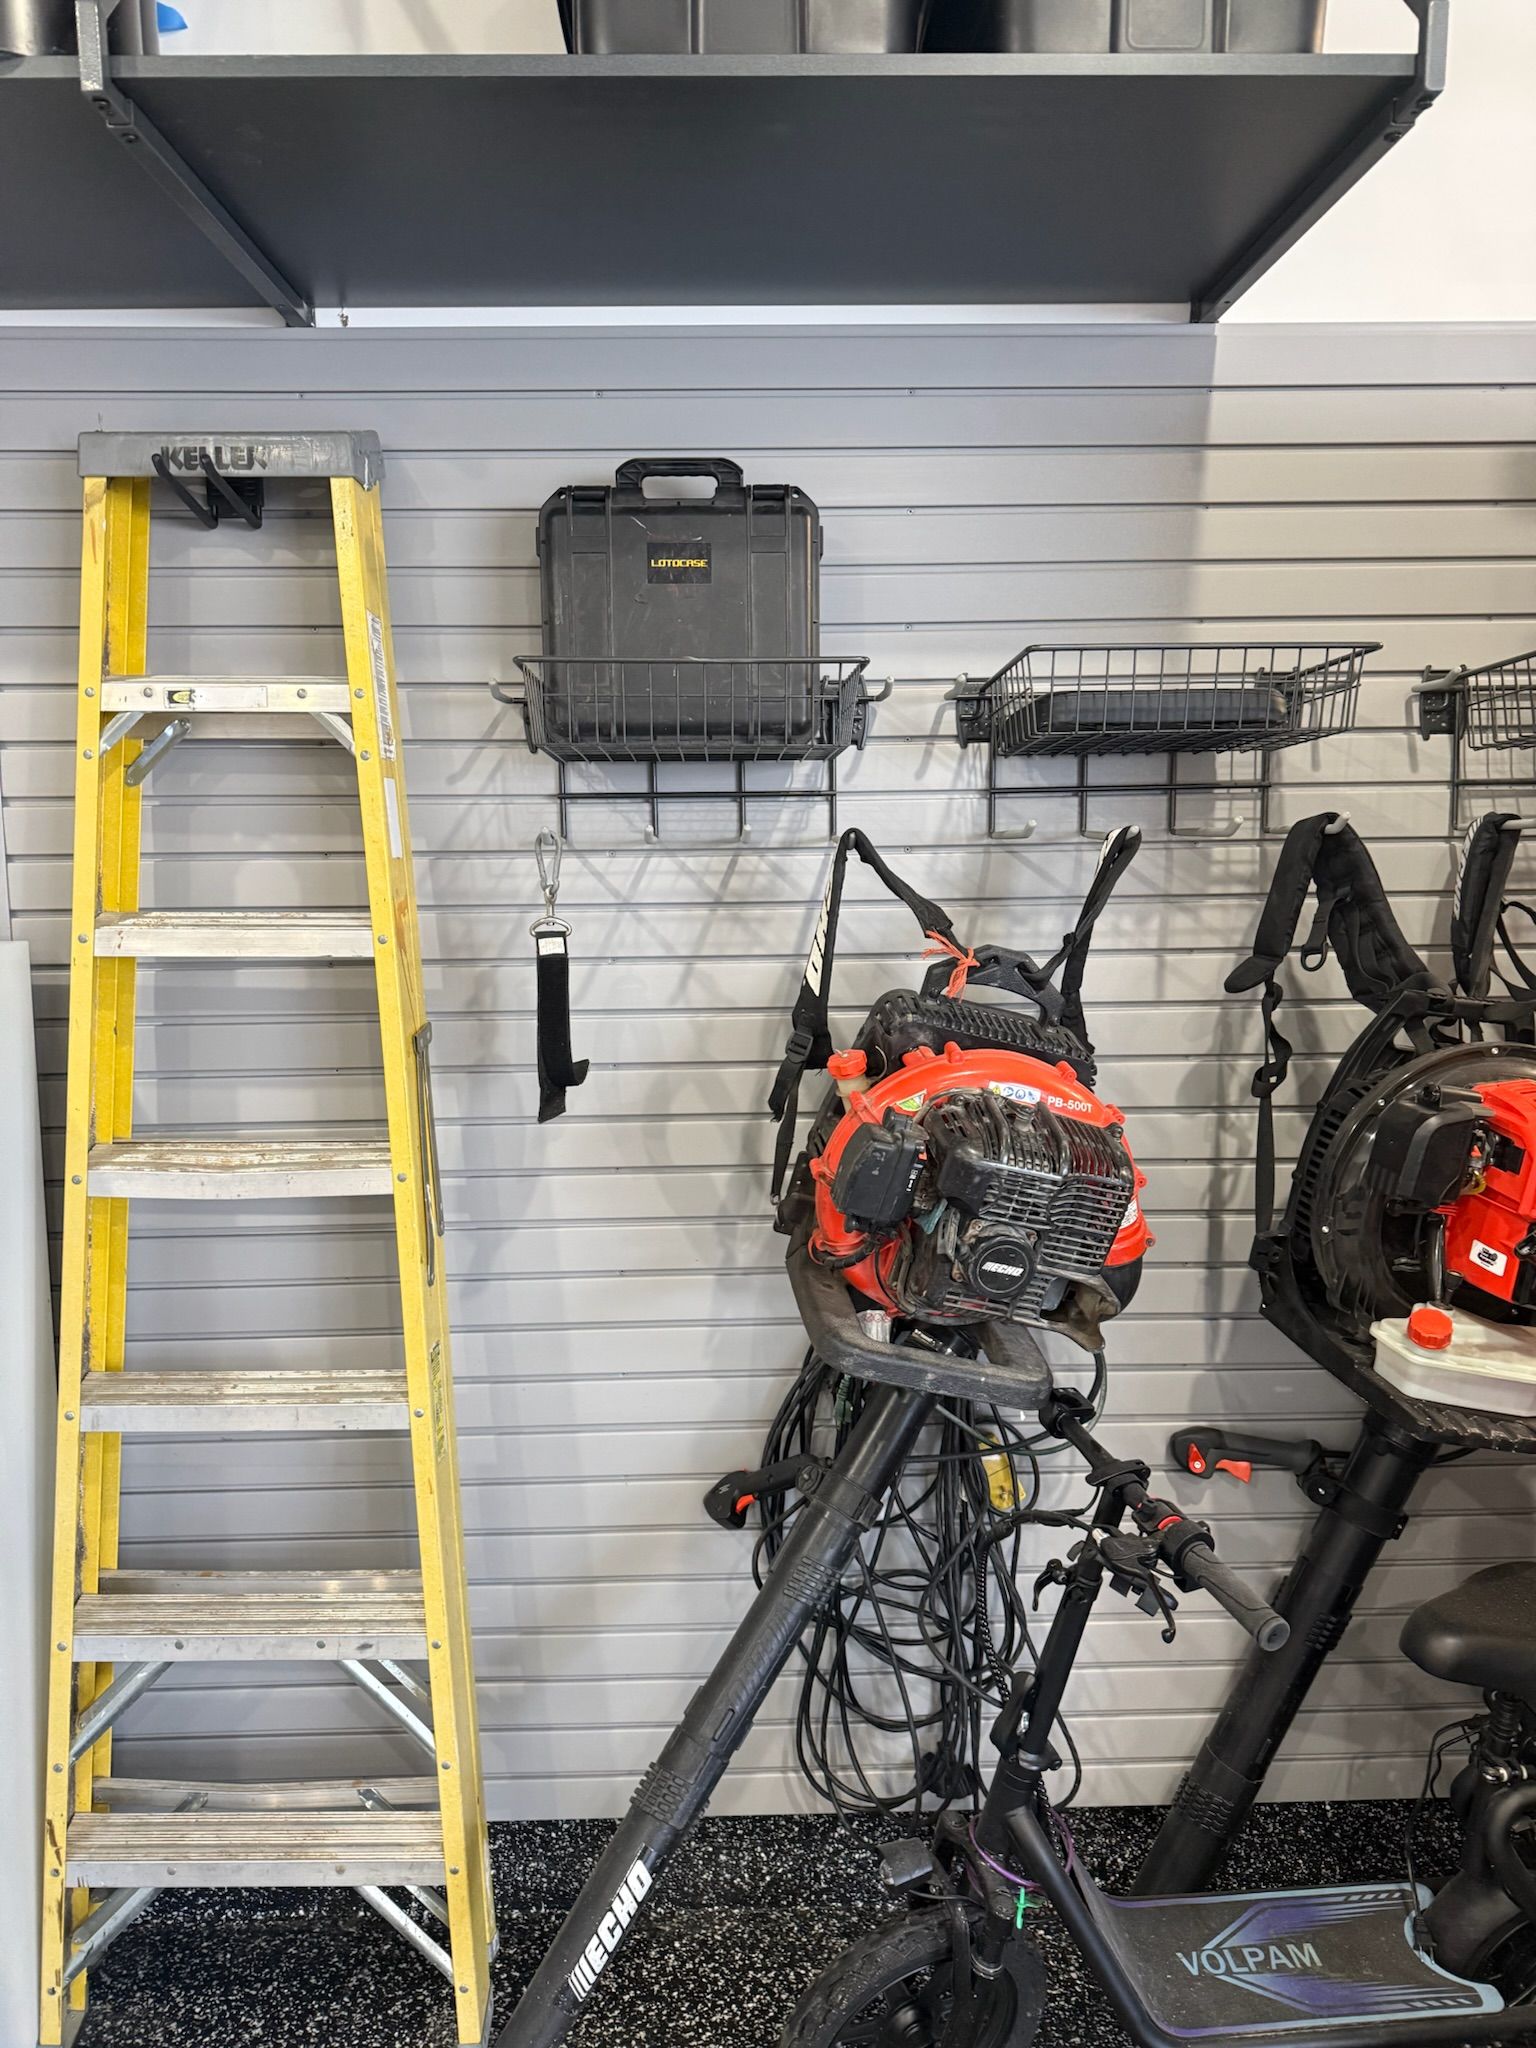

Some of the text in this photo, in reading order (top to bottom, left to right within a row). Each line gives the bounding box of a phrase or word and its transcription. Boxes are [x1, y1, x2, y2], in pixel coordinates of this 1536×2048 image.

[651, 559, 708, 568] LOTOCASE
[1047, 1095, 1093, 1113] PB-500T
[989, 1263, 1024, 1277] ECHO
[584, 1859, 653, 1975] ECHO
[1176, 1942, 1323, 1976] VOLPAM
